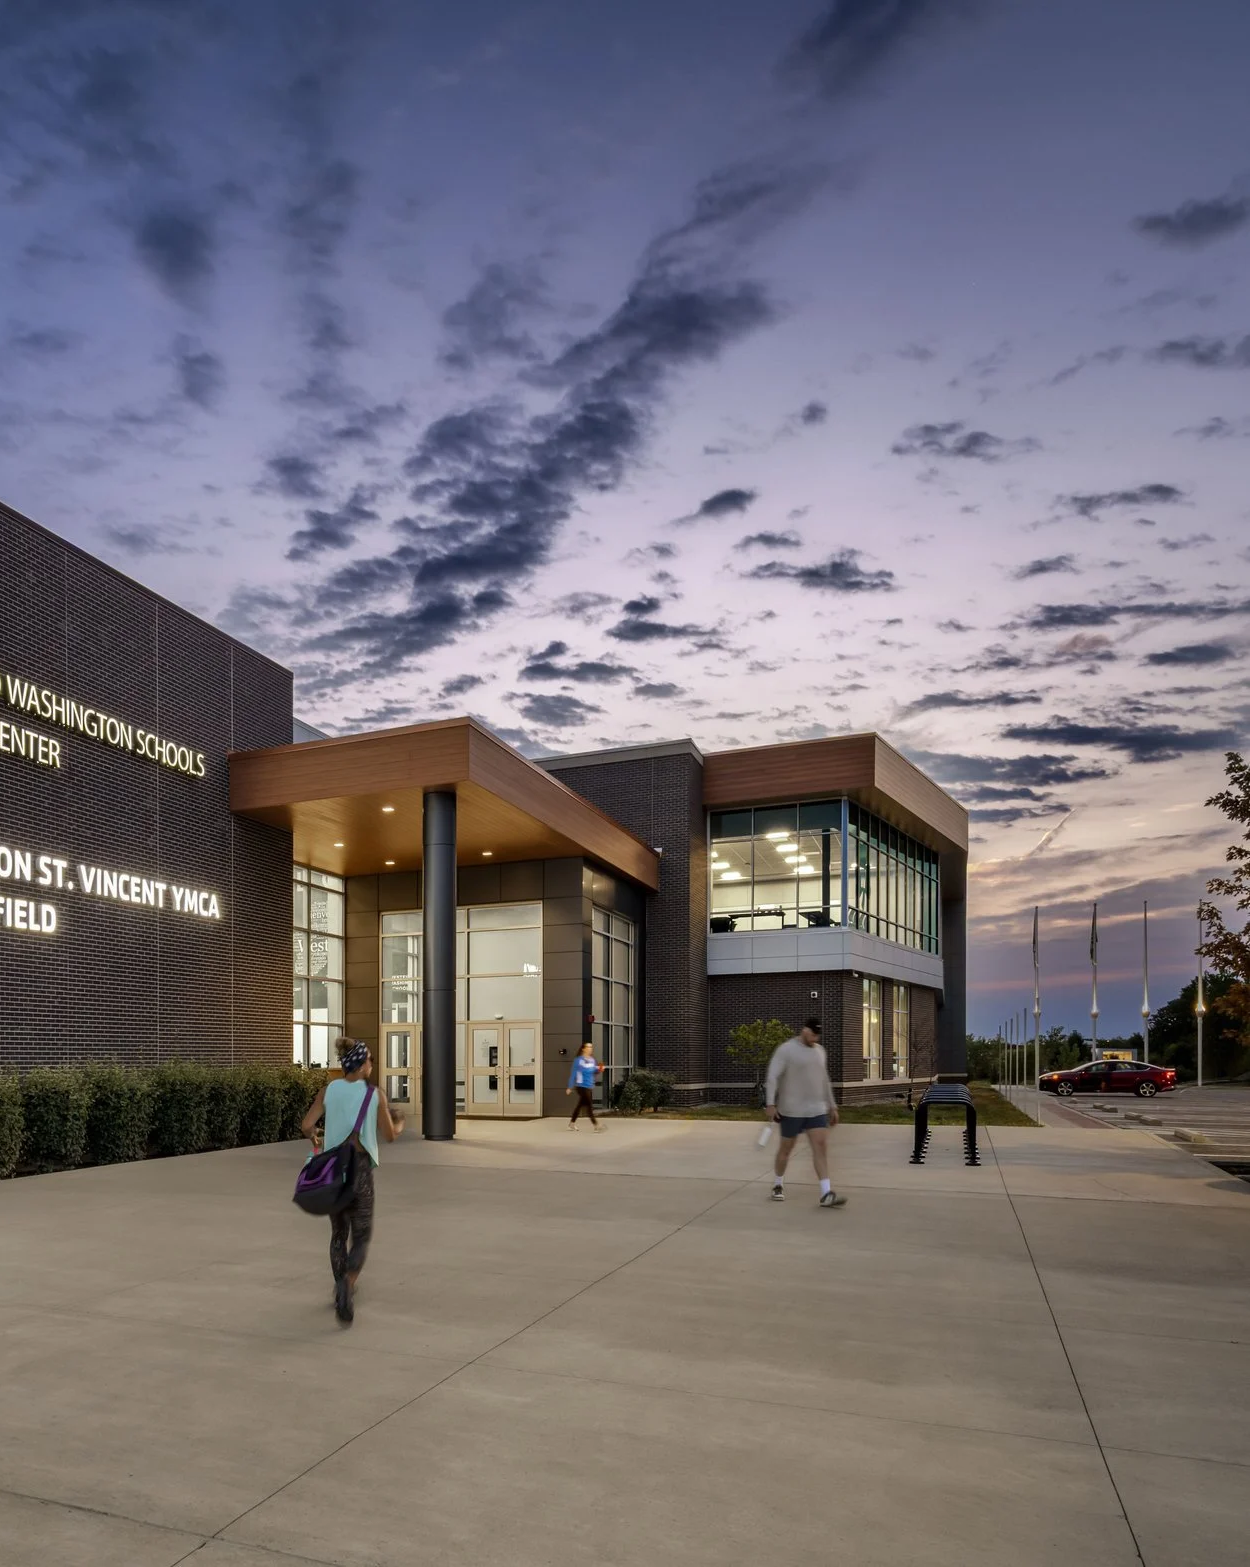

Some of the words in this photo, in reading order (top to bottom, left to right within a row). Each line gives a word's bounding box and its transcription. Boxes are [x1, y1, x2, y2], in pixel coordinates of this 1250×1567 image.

[6, 674, 133, 750] WASHINGTON
[136, 729, 205, 777] SCHOOLS
[36, 856, 74, 890] ST.
[77, 864, 167, 908] VINCENT
[171, 885, 220, 919] YMCA
